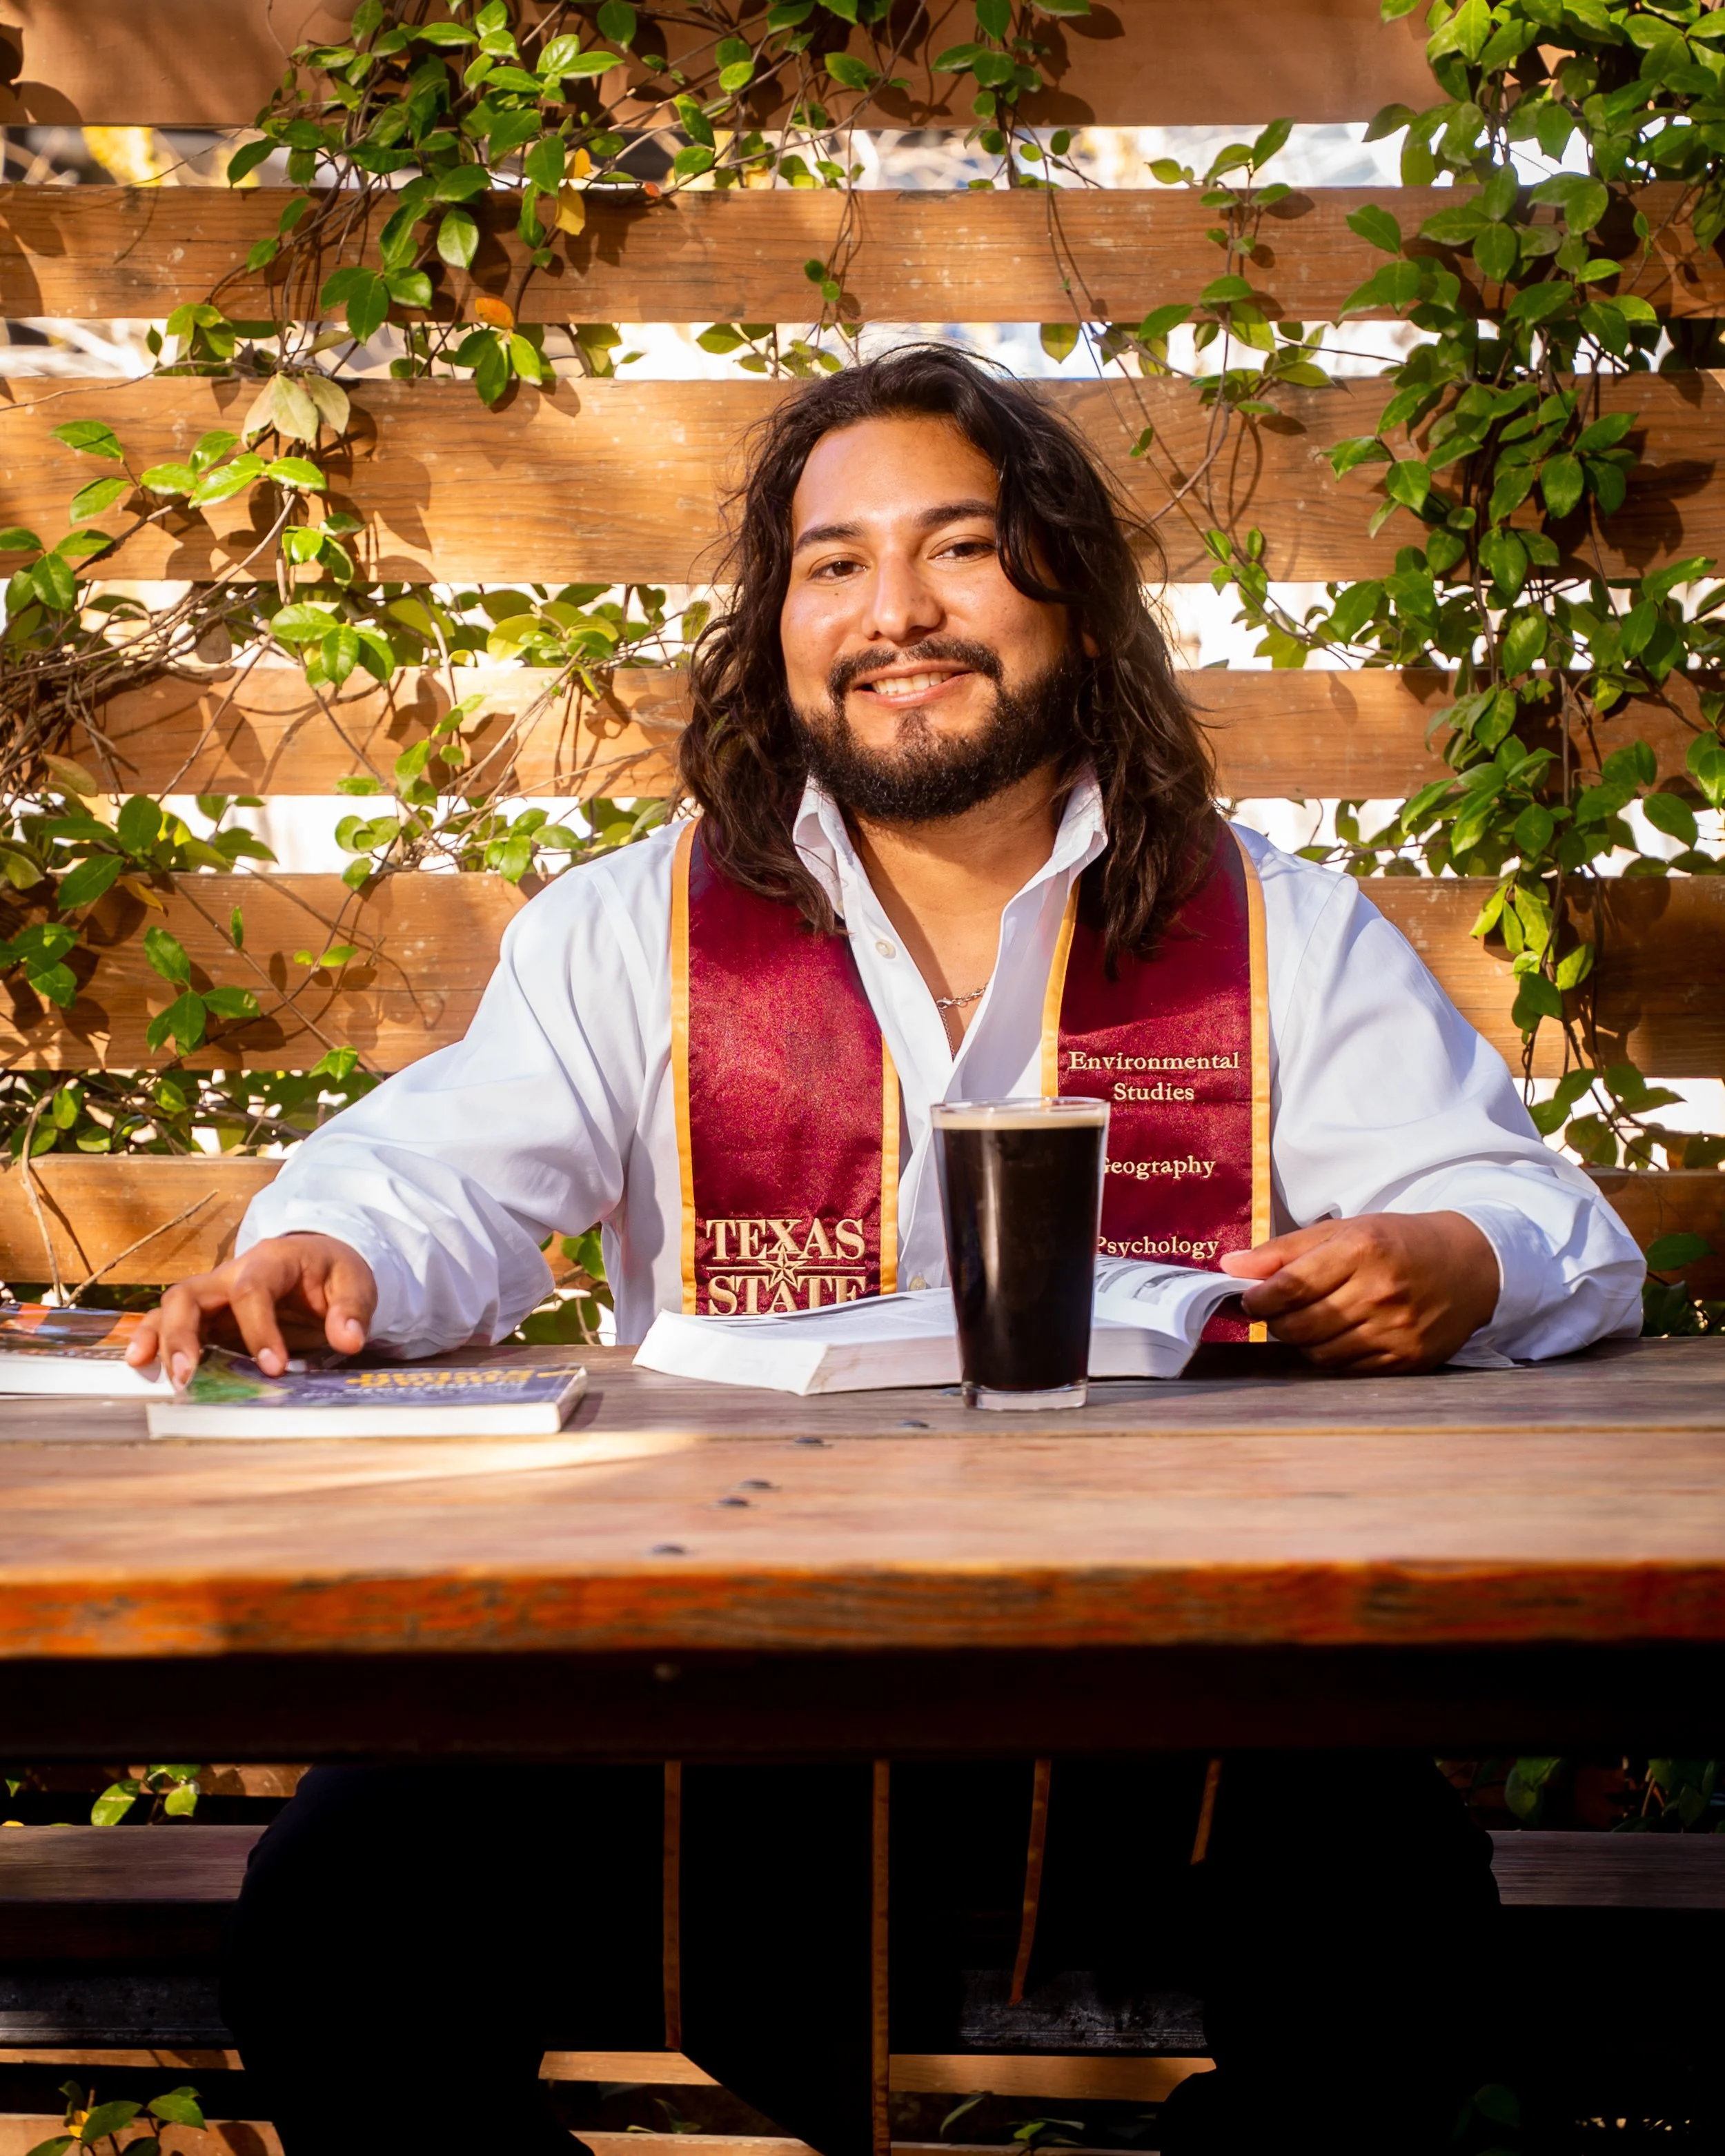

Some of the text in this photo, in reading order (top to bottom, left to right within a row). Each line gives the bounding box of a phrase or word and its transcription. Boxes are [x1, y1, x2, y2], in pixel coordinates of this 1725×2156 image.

[1069, 1051, 1241, 1069] Environmental
[1113, 1082, 1195, 1100] Studies
[706, 1218, 865, 1260] TEXAS
